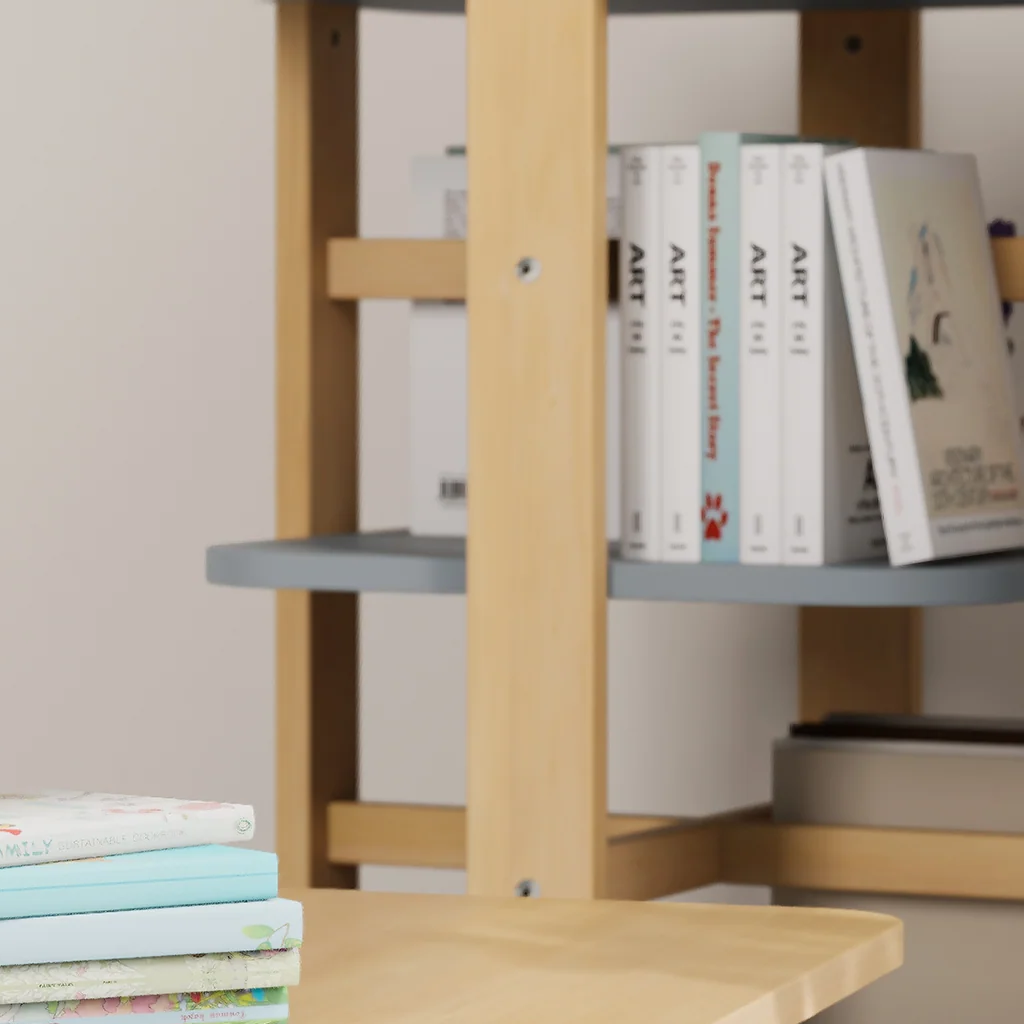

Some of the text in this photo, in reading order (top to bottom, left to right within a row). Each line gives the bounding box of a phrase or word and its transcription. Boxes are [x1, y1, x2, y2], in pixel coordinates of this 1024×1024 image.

[629, 242, 646, 309] ART
[669, 242, 686, 308] ART
[750, 242, 767, 309] ART
[791, 242, 808, 309] ART
